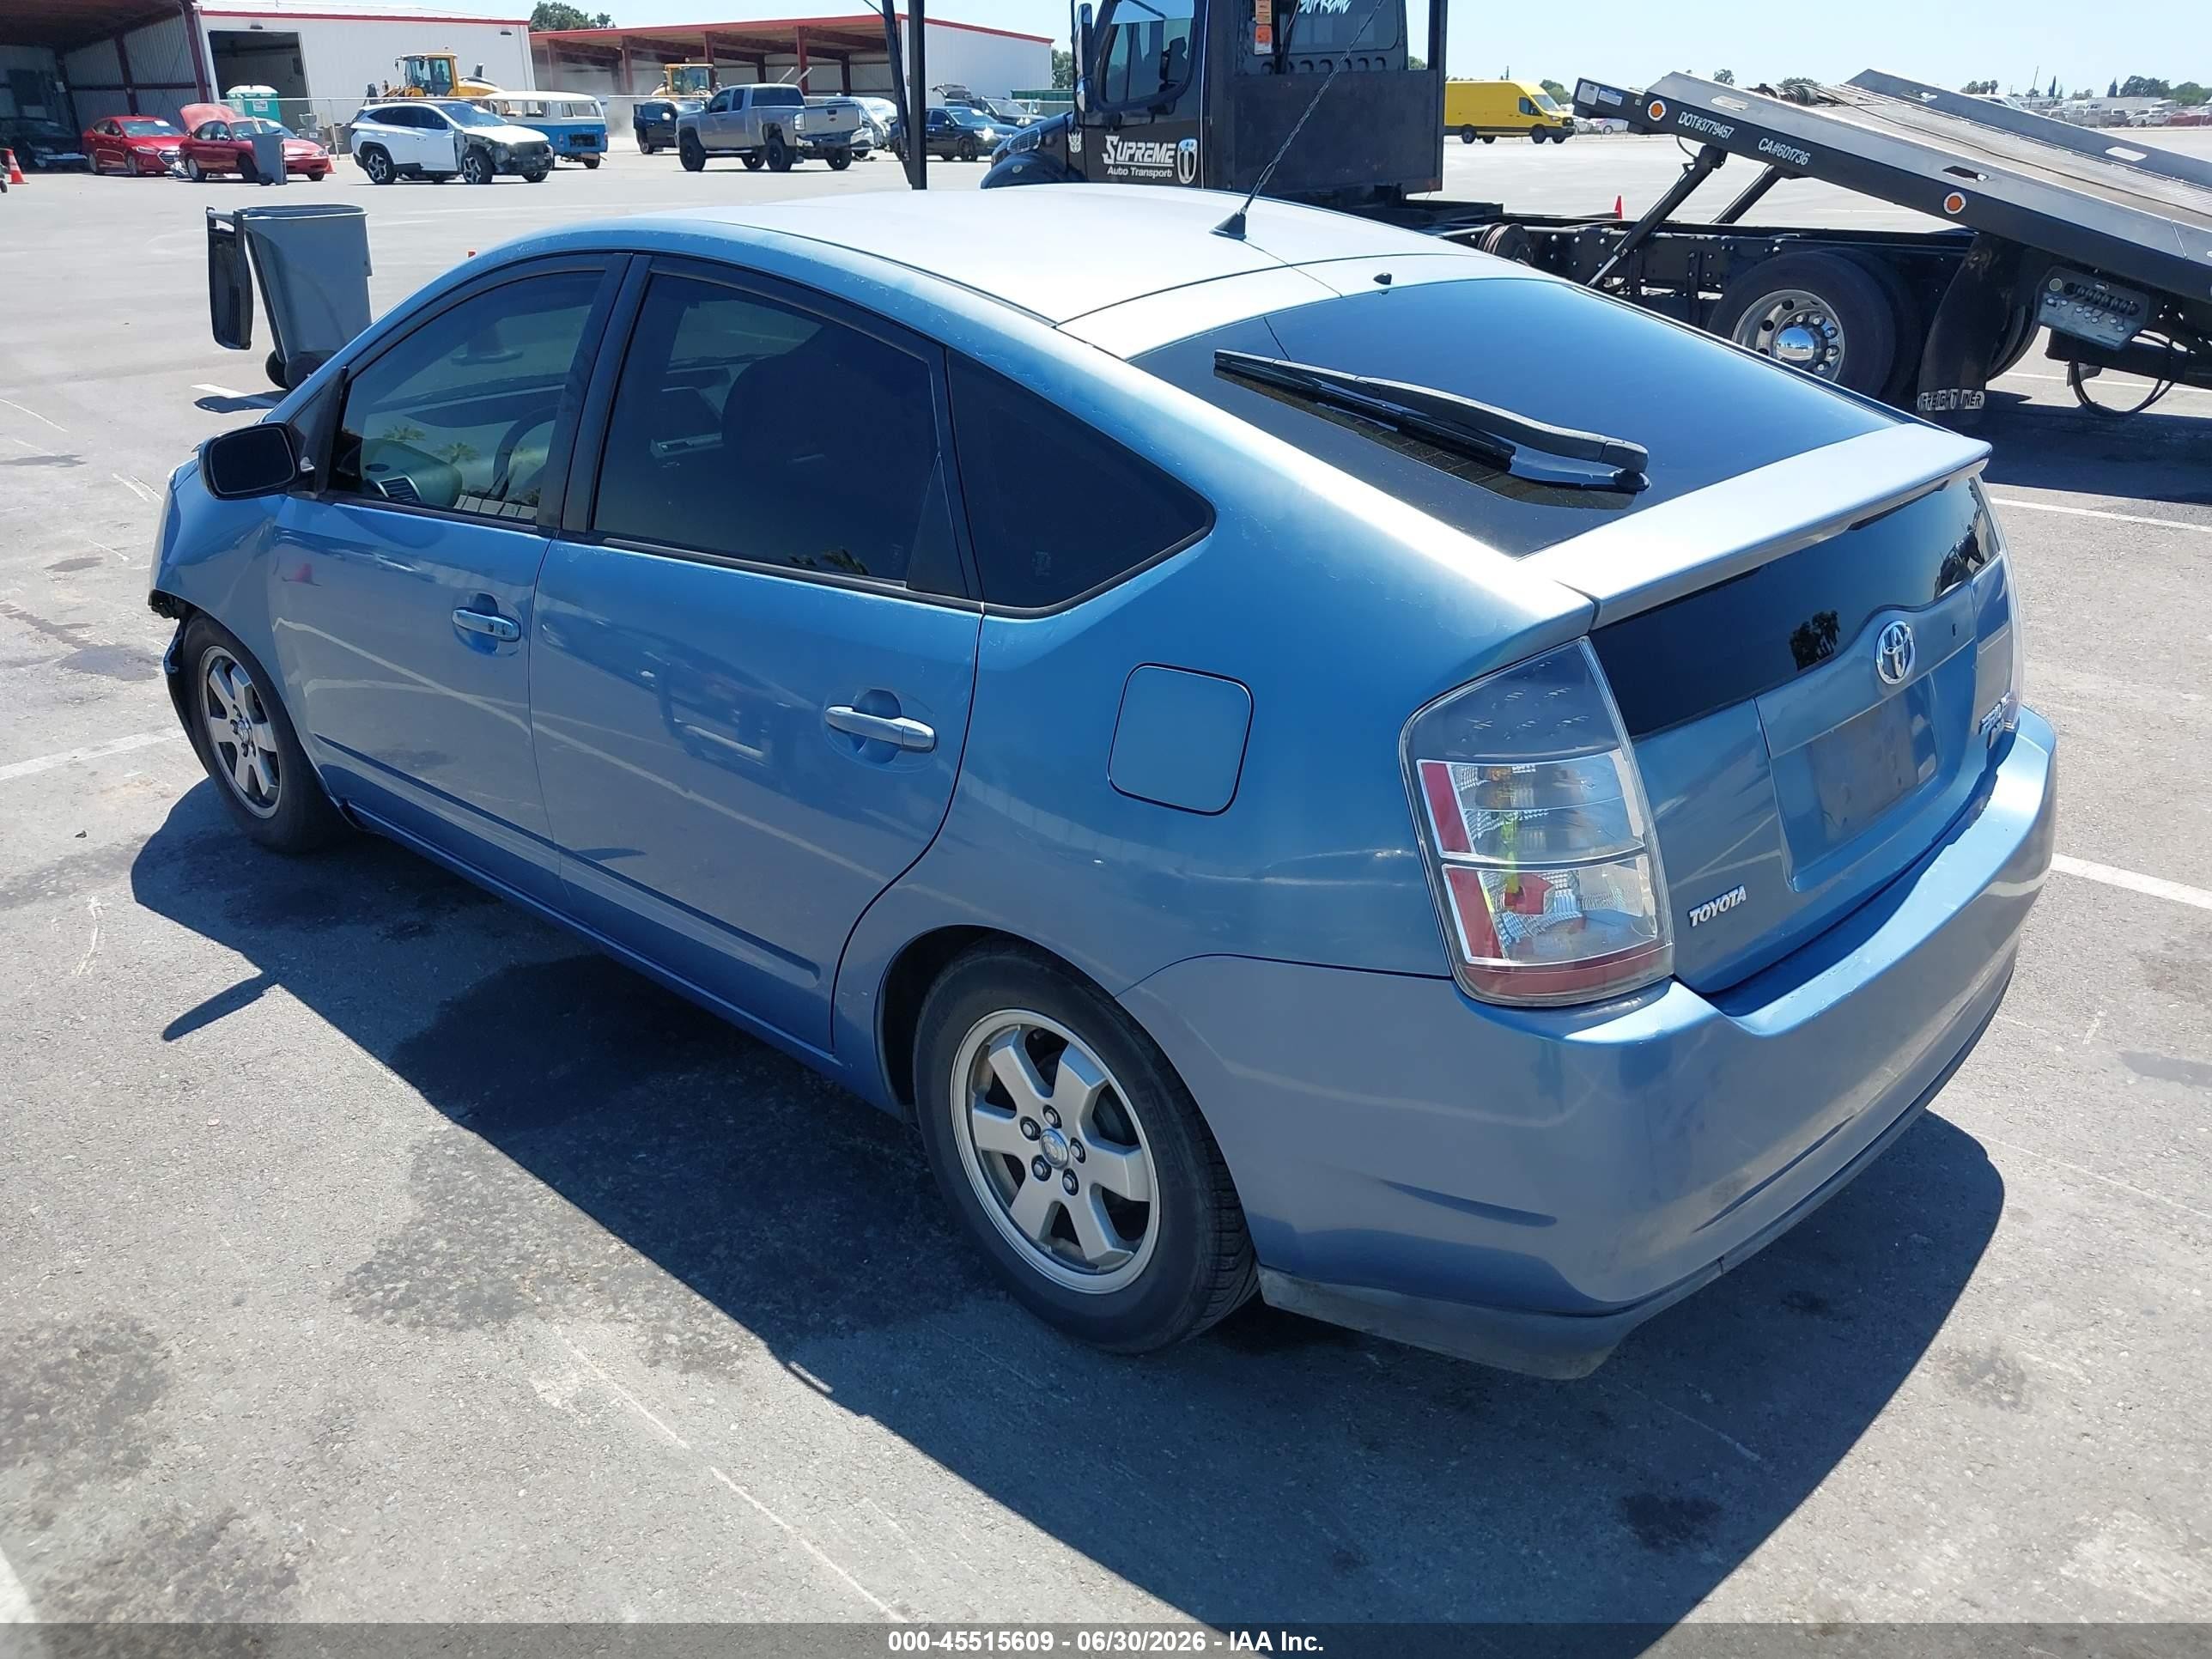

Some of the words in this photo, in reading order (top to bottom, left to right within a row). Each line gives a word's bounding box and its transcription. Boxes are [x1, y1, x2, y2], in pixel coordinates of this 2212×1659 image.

[1678, 112, 1735, 139] DOT#3779457
[1102, 135, 1176, 164] SUPREME
[1758, 137, 1811, 166] CA#601736
[1107, 166, 1128, 176] Auto
[1130, 167, 1173, 179] Transport
[1688, 884, 1747, 927] TOYOTA
